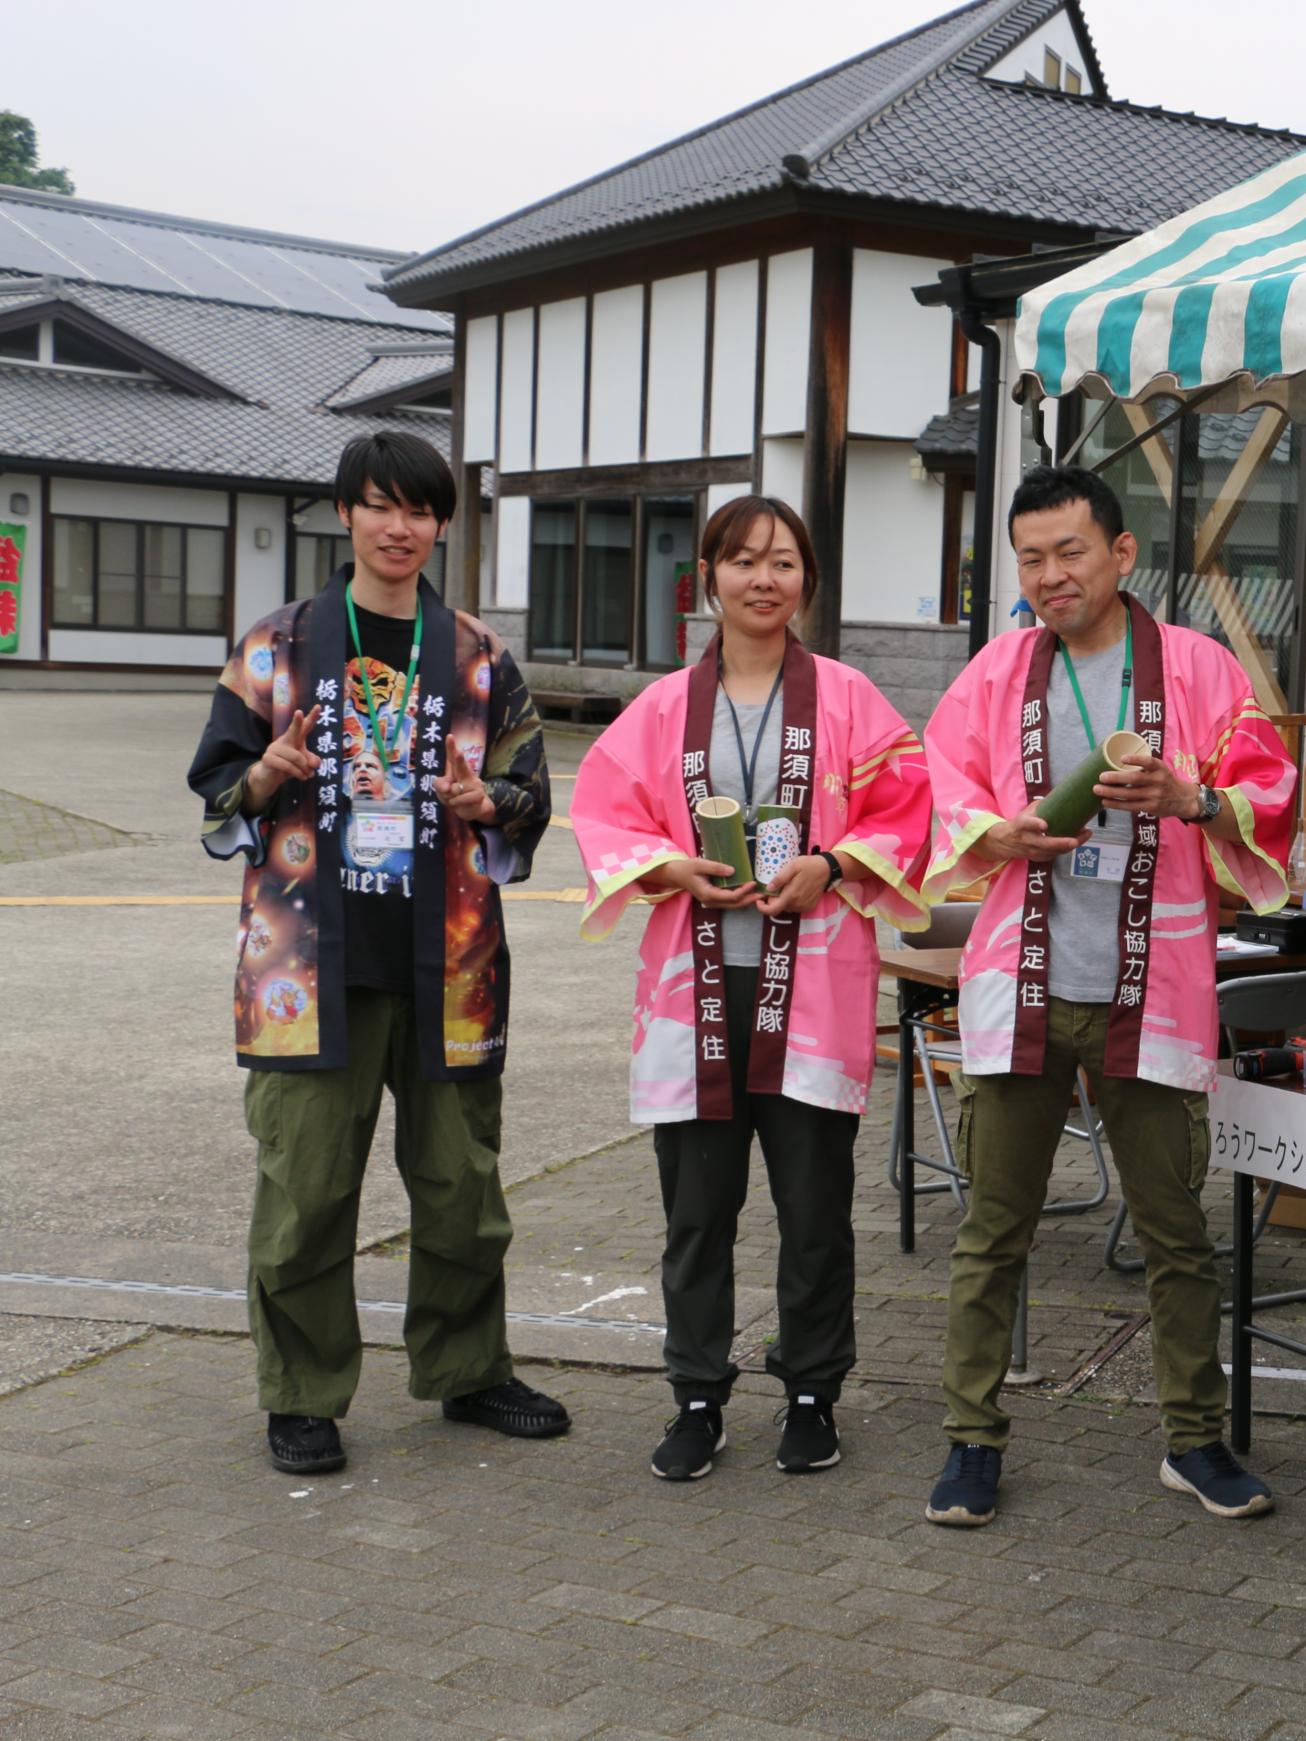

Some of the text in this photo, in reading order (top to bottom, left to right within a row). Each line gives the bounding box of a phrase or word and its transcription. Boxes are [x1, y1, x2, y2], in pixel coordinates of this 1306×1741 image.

[315, 679, 339, 833] 栃木県那須町
[419, 694, 445, 849] 栃木県那須町
[780, 725, 811, 809] 那須町
